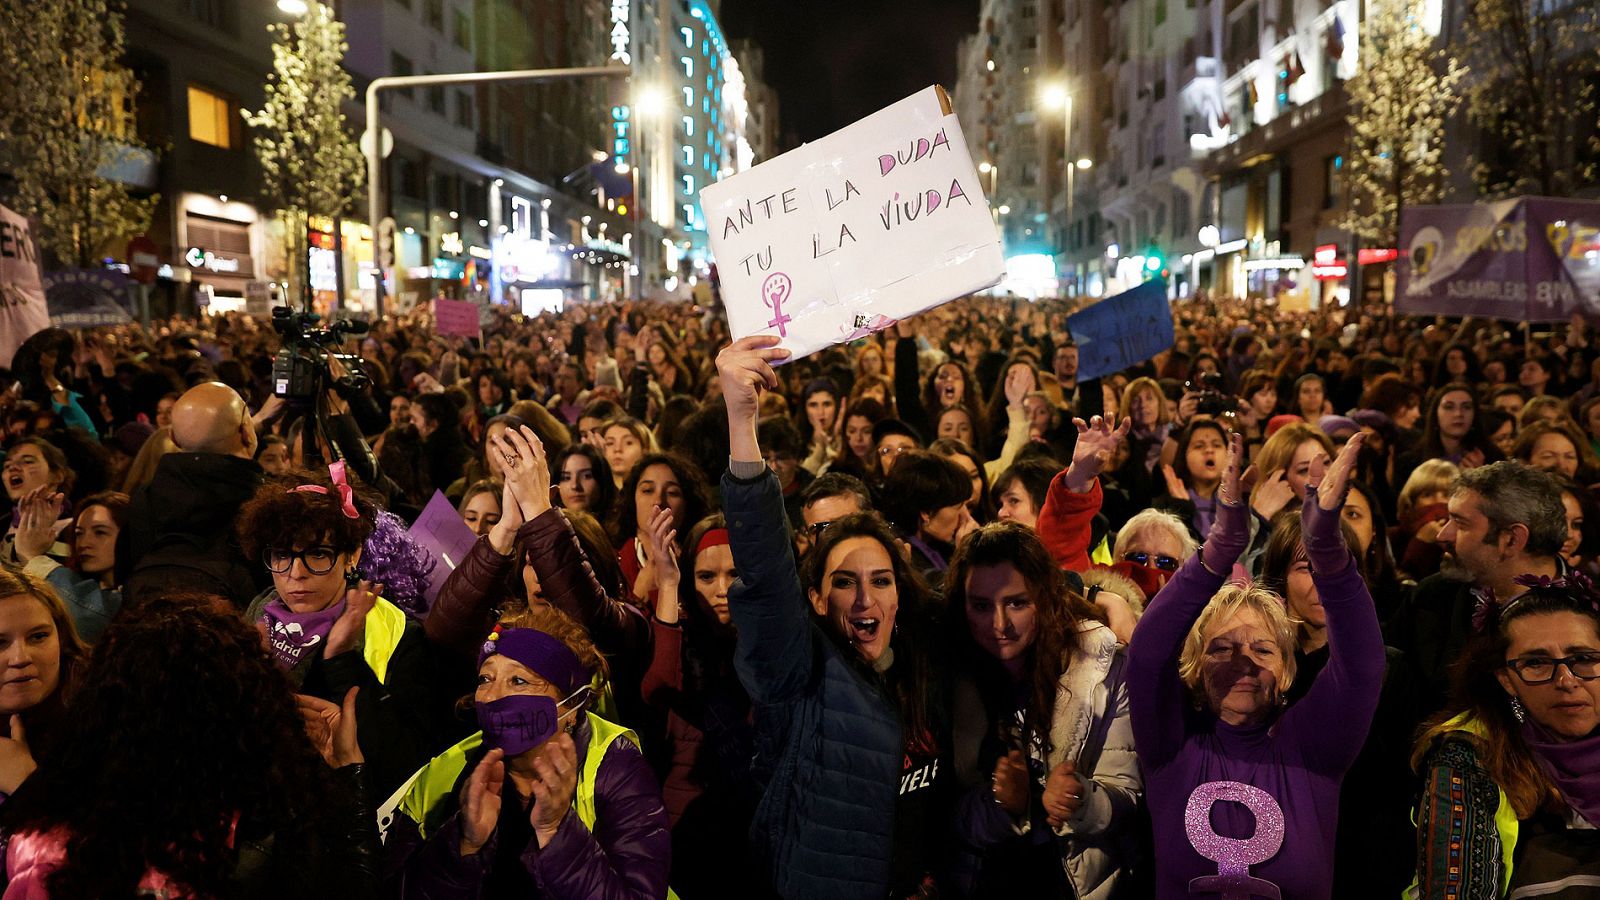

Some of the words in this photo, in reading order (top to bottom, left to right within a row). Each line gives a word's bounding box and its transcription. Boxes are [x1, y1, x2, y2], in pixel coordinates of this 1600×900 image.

[723, 187, 798, 240] ANTE
[825, 179, 861, 211] LA
[878, 127, 951, 177] DUDA
[738, 245, 773, 276] TU
[812, 223, 857, 259] LA
